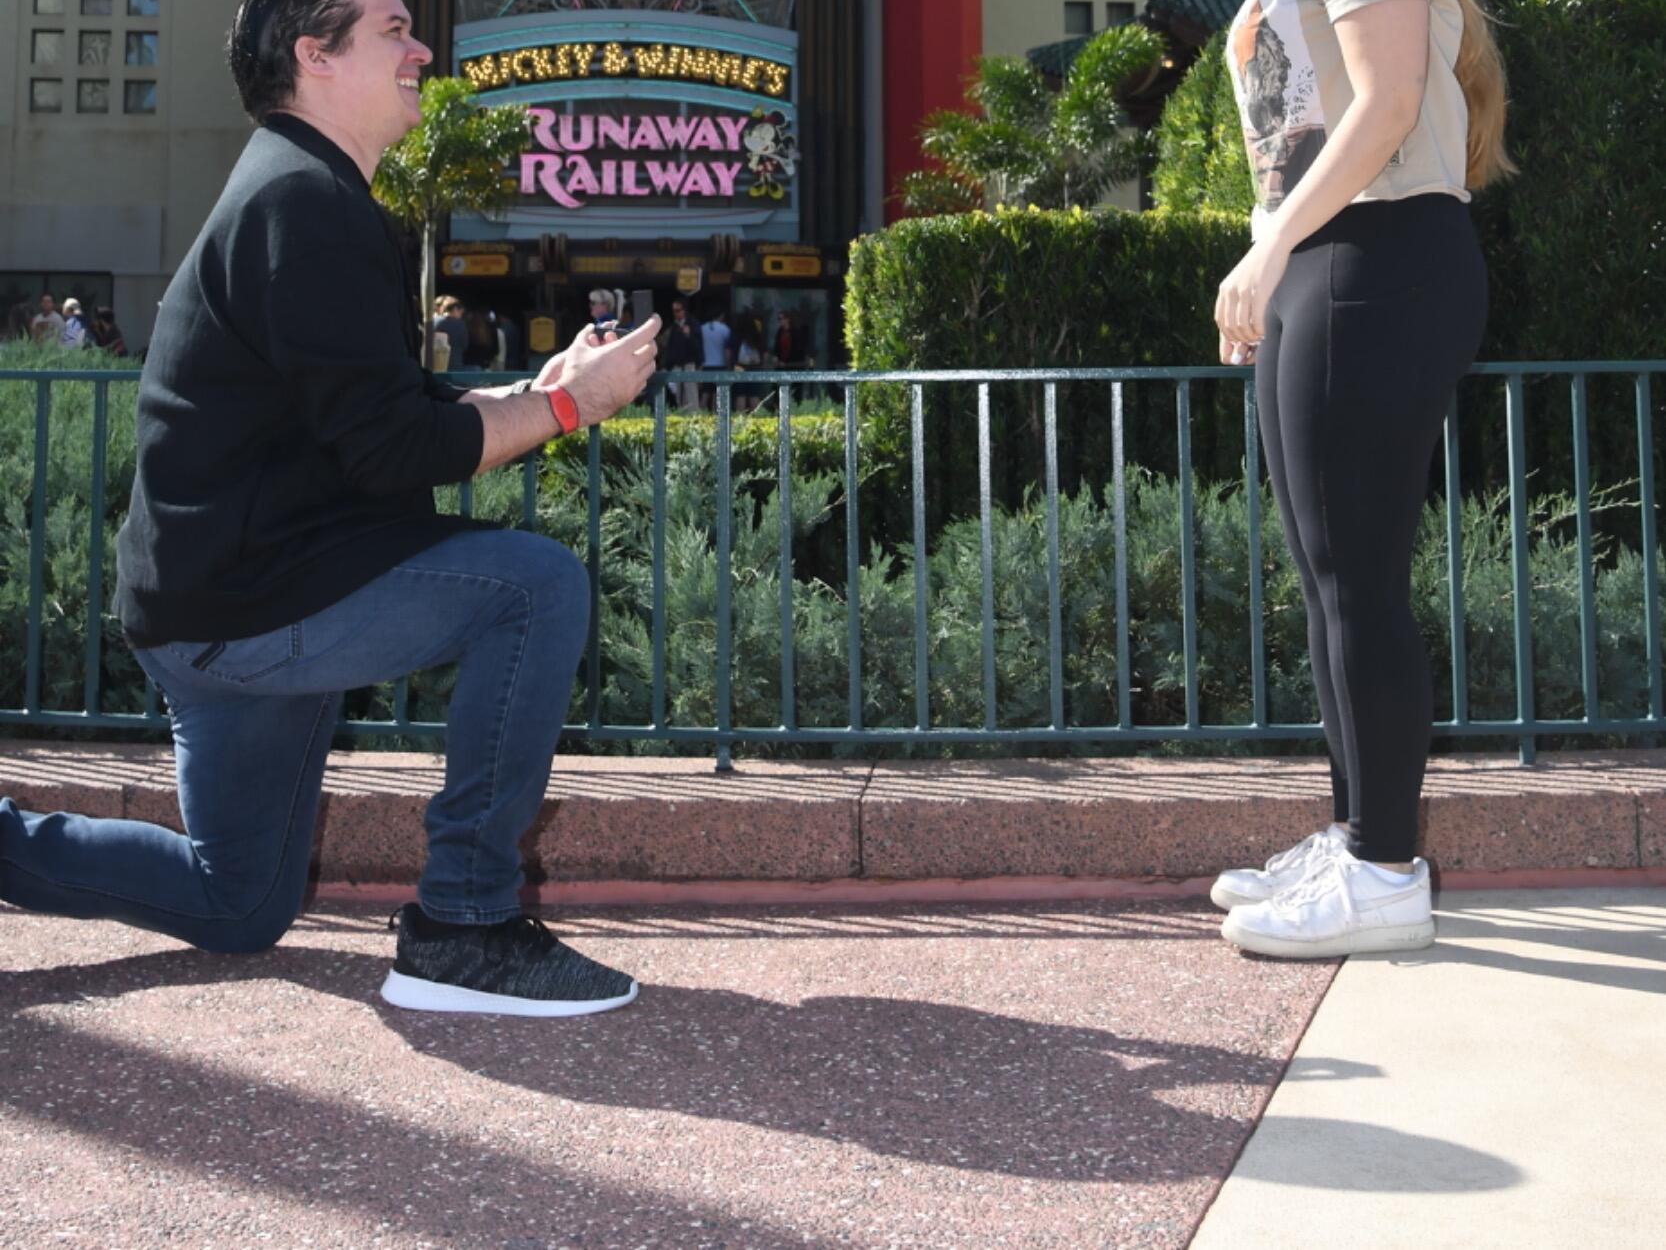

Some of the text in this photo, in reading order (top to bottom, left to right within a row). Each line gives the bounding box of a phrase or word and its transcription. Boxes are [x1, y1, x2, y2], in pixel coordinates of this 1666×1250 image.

[463, 41, 789, 96] MICKEY & MINNIE'S
[527, 108, 748, 151] RUNAWAY
[520, 153, 743, 208] RAILWAY
